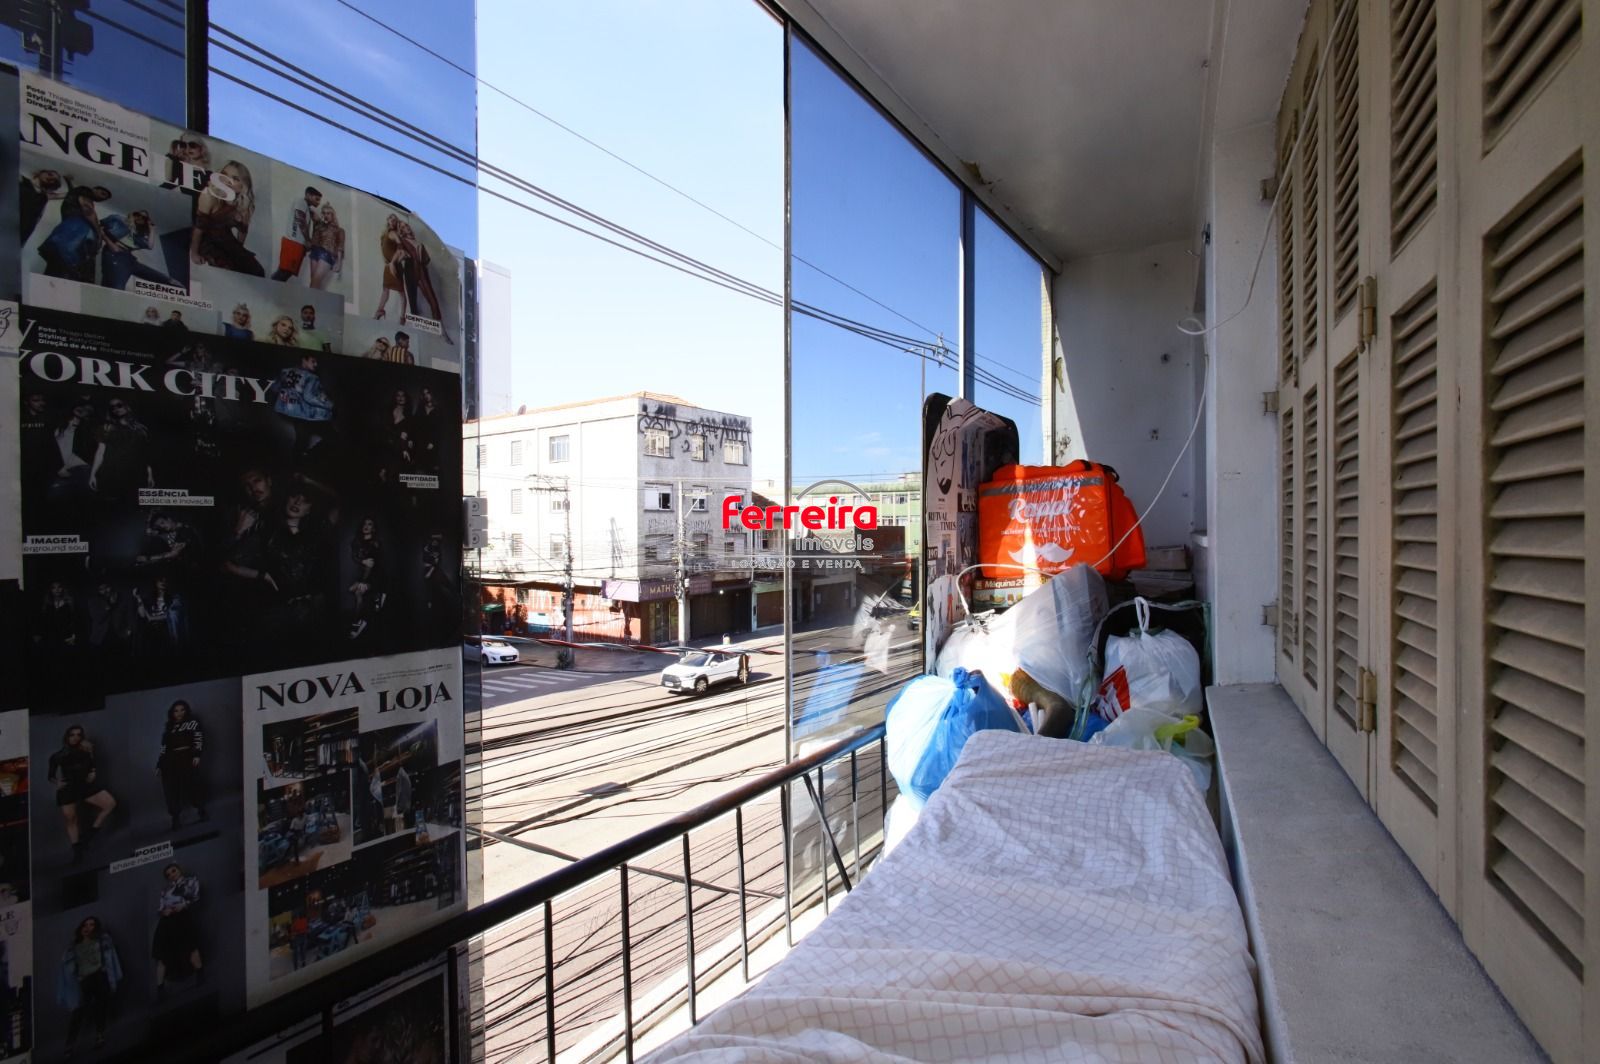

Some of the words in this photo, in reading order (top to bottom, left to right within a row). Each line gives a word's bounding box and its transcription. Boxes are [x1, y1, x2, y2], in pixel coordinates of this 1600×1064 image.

[26, 92, 56, 107] Styling
[26, 98, 58, 113] Direção
[59, 109, 70, 117] de
[71, 113, 89, 123] Arte
[135, 281, 186, 297] ESSÊNCIA
[135, 290, 169, 300] audácia
[177, 296, 212, 309] inovação
[38, 332, 67, 342] Styling
[38, 339, 69, 348] Direção
[163, 368, 275, 404] CITY
[256, 671, 365, 711] NOVA
[377, 681, 452, 713] LOJA
[136, 843, 169, 857] PODER
